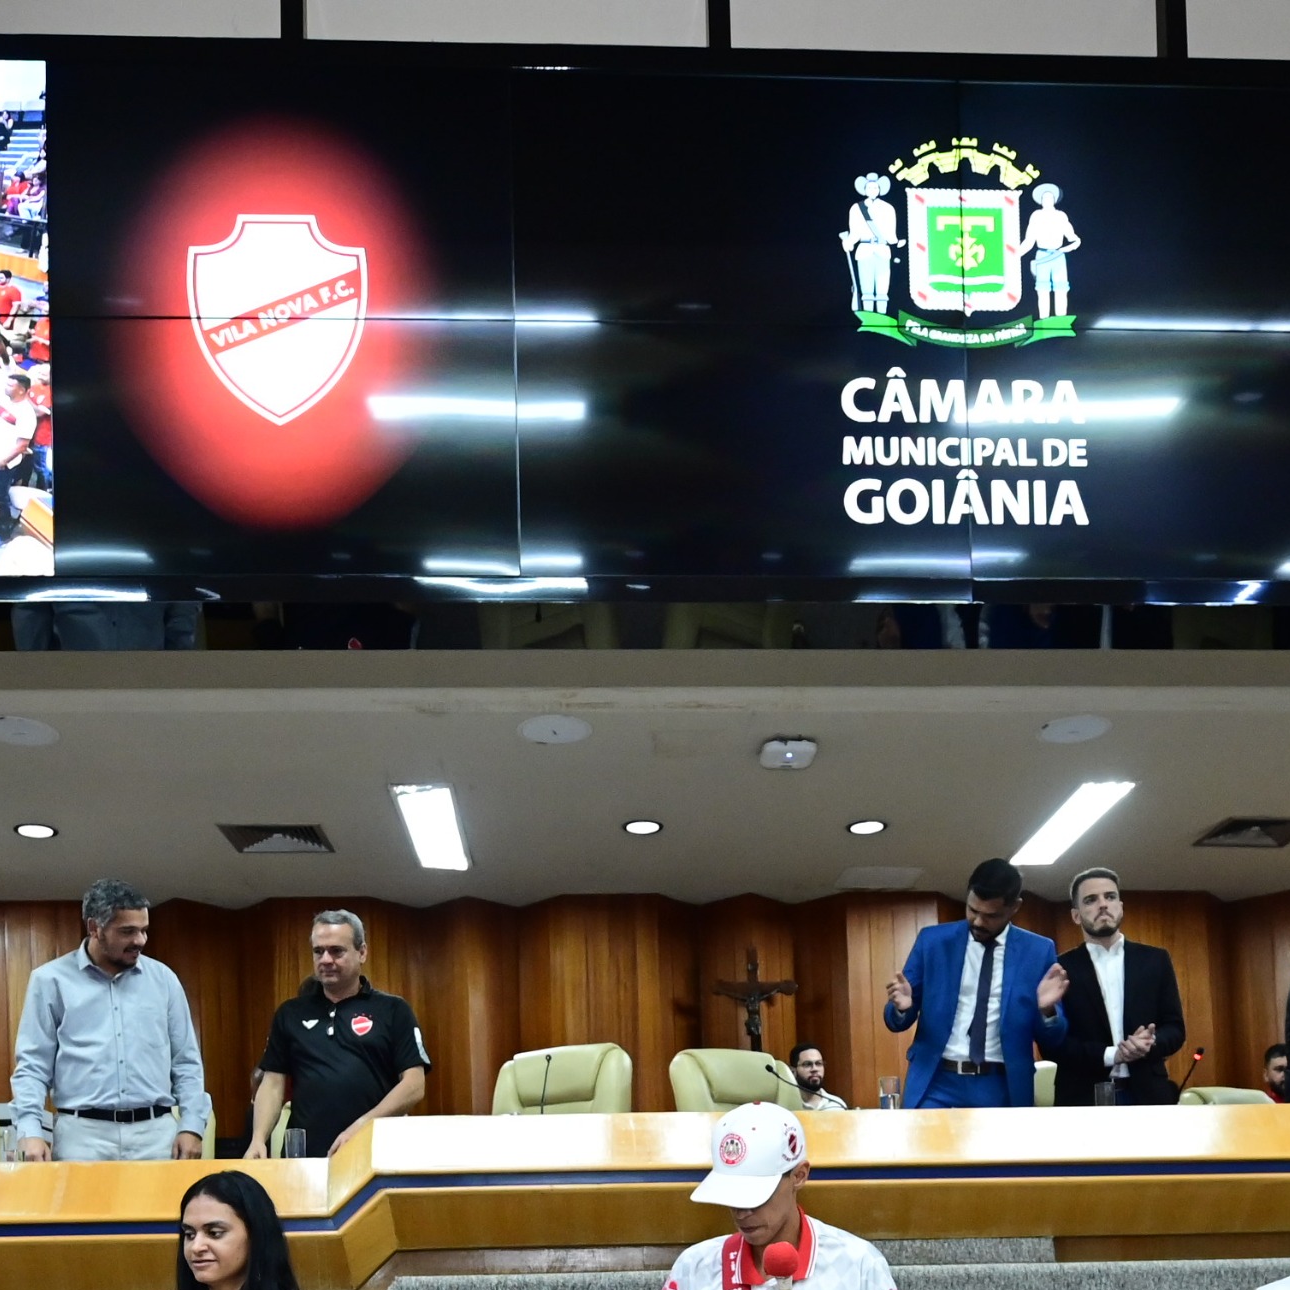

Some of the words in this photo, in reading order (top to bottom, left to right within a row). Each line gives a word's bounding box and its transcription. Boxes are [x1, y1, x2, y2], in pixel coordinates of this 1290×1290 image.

[210, 322, 258, 347] VILA
[258, 292, 319, 331] NOVA
[319, 280, 355, 303] F.C.
[841, 367, 1086, 423] CÂMARA
[843, 436, 1037, 466] MUNICIPAL
[1043, 438, 1088, 466] DE
[844, 468, 1089, 525] GOIÂNIA
